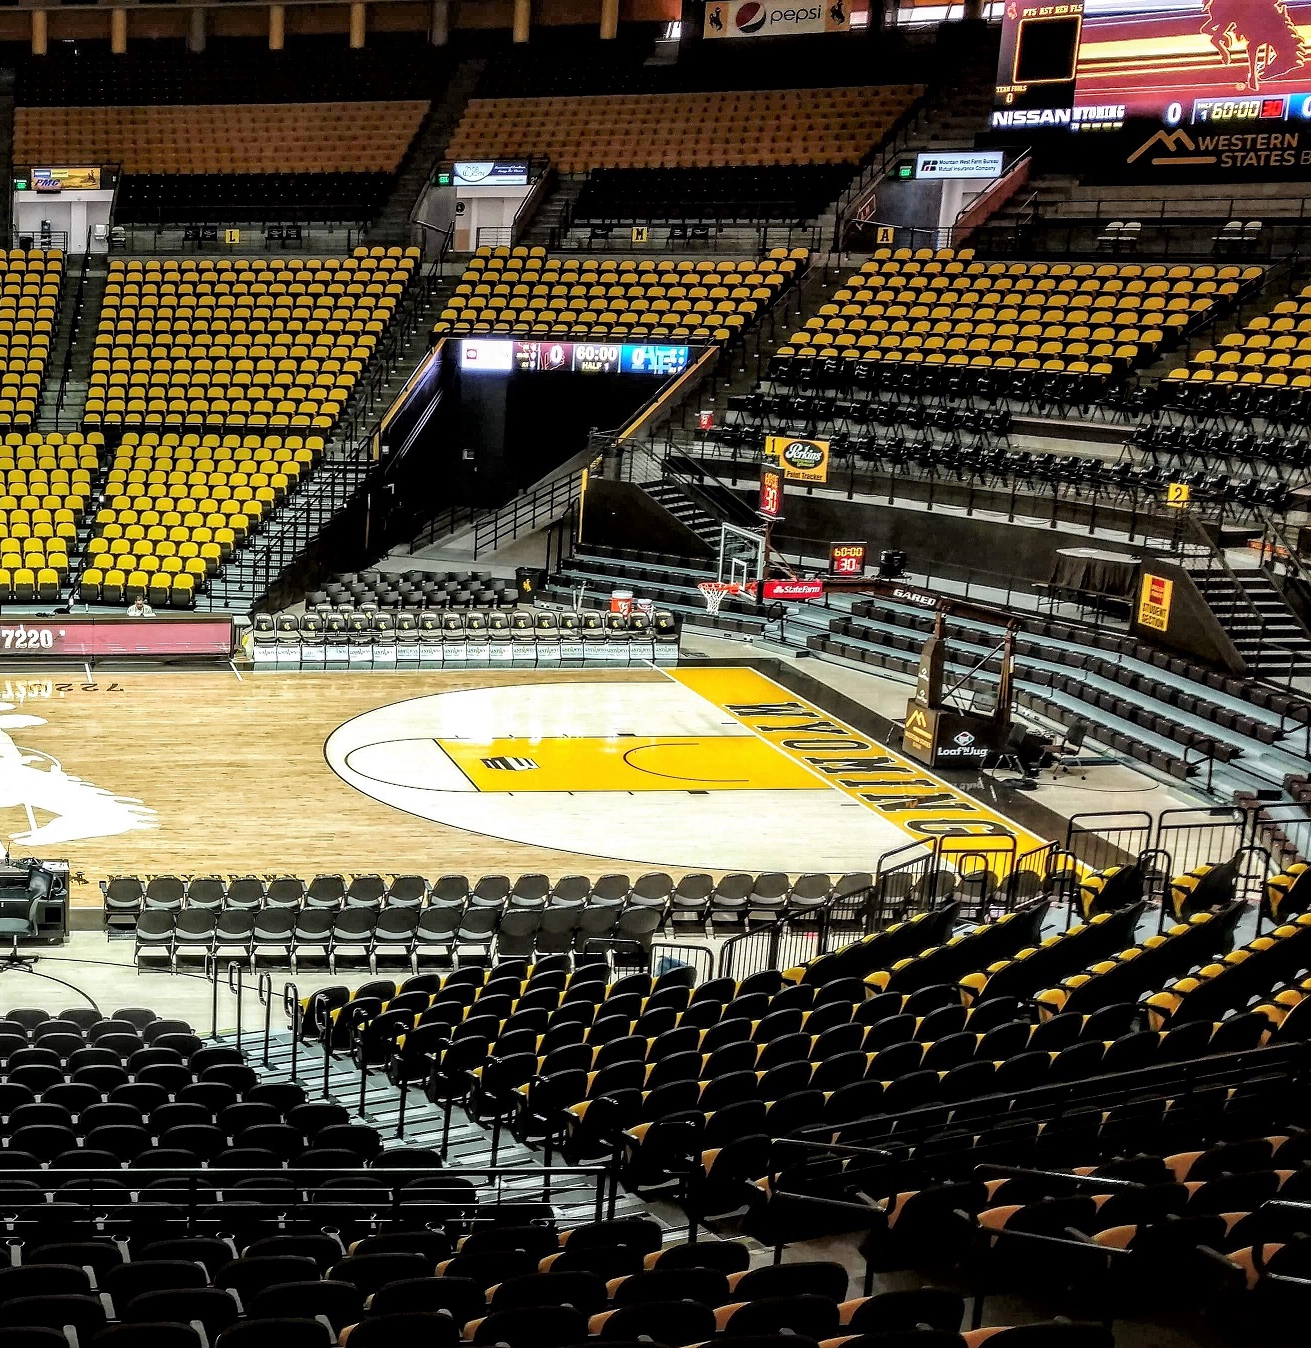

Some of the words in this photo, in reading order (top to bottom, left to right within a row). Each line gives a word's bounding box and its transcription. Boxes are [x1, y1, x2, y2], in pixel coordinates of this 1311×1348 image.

[770, 5, 822, 25] pepsi
[992, 109, 1071, 125] NISSAN
[1166, 102, 1182, 123] 0
[1211, 101, 1261, 119] 60:00
[1198, 132, 1299, 151] WESTERN
[1220, 150, 1296, 167] STATES
[229, 231, 236, 242] L
[880, 229, 890, 241] A
[550, 345, 563, 362] 0
[576, 346, 618, 360] 60:00
[582, 362, 602, 370] HALF
[771, 438, 776, 453] 1
[785, 443, 823, 460] Perkins
[1174, 487, 1183, 501] 2
[840, 558, 856, 571] 30
[893, 588, 936, 606] GARED
[721, 702, 1020, 837] WYOMING
